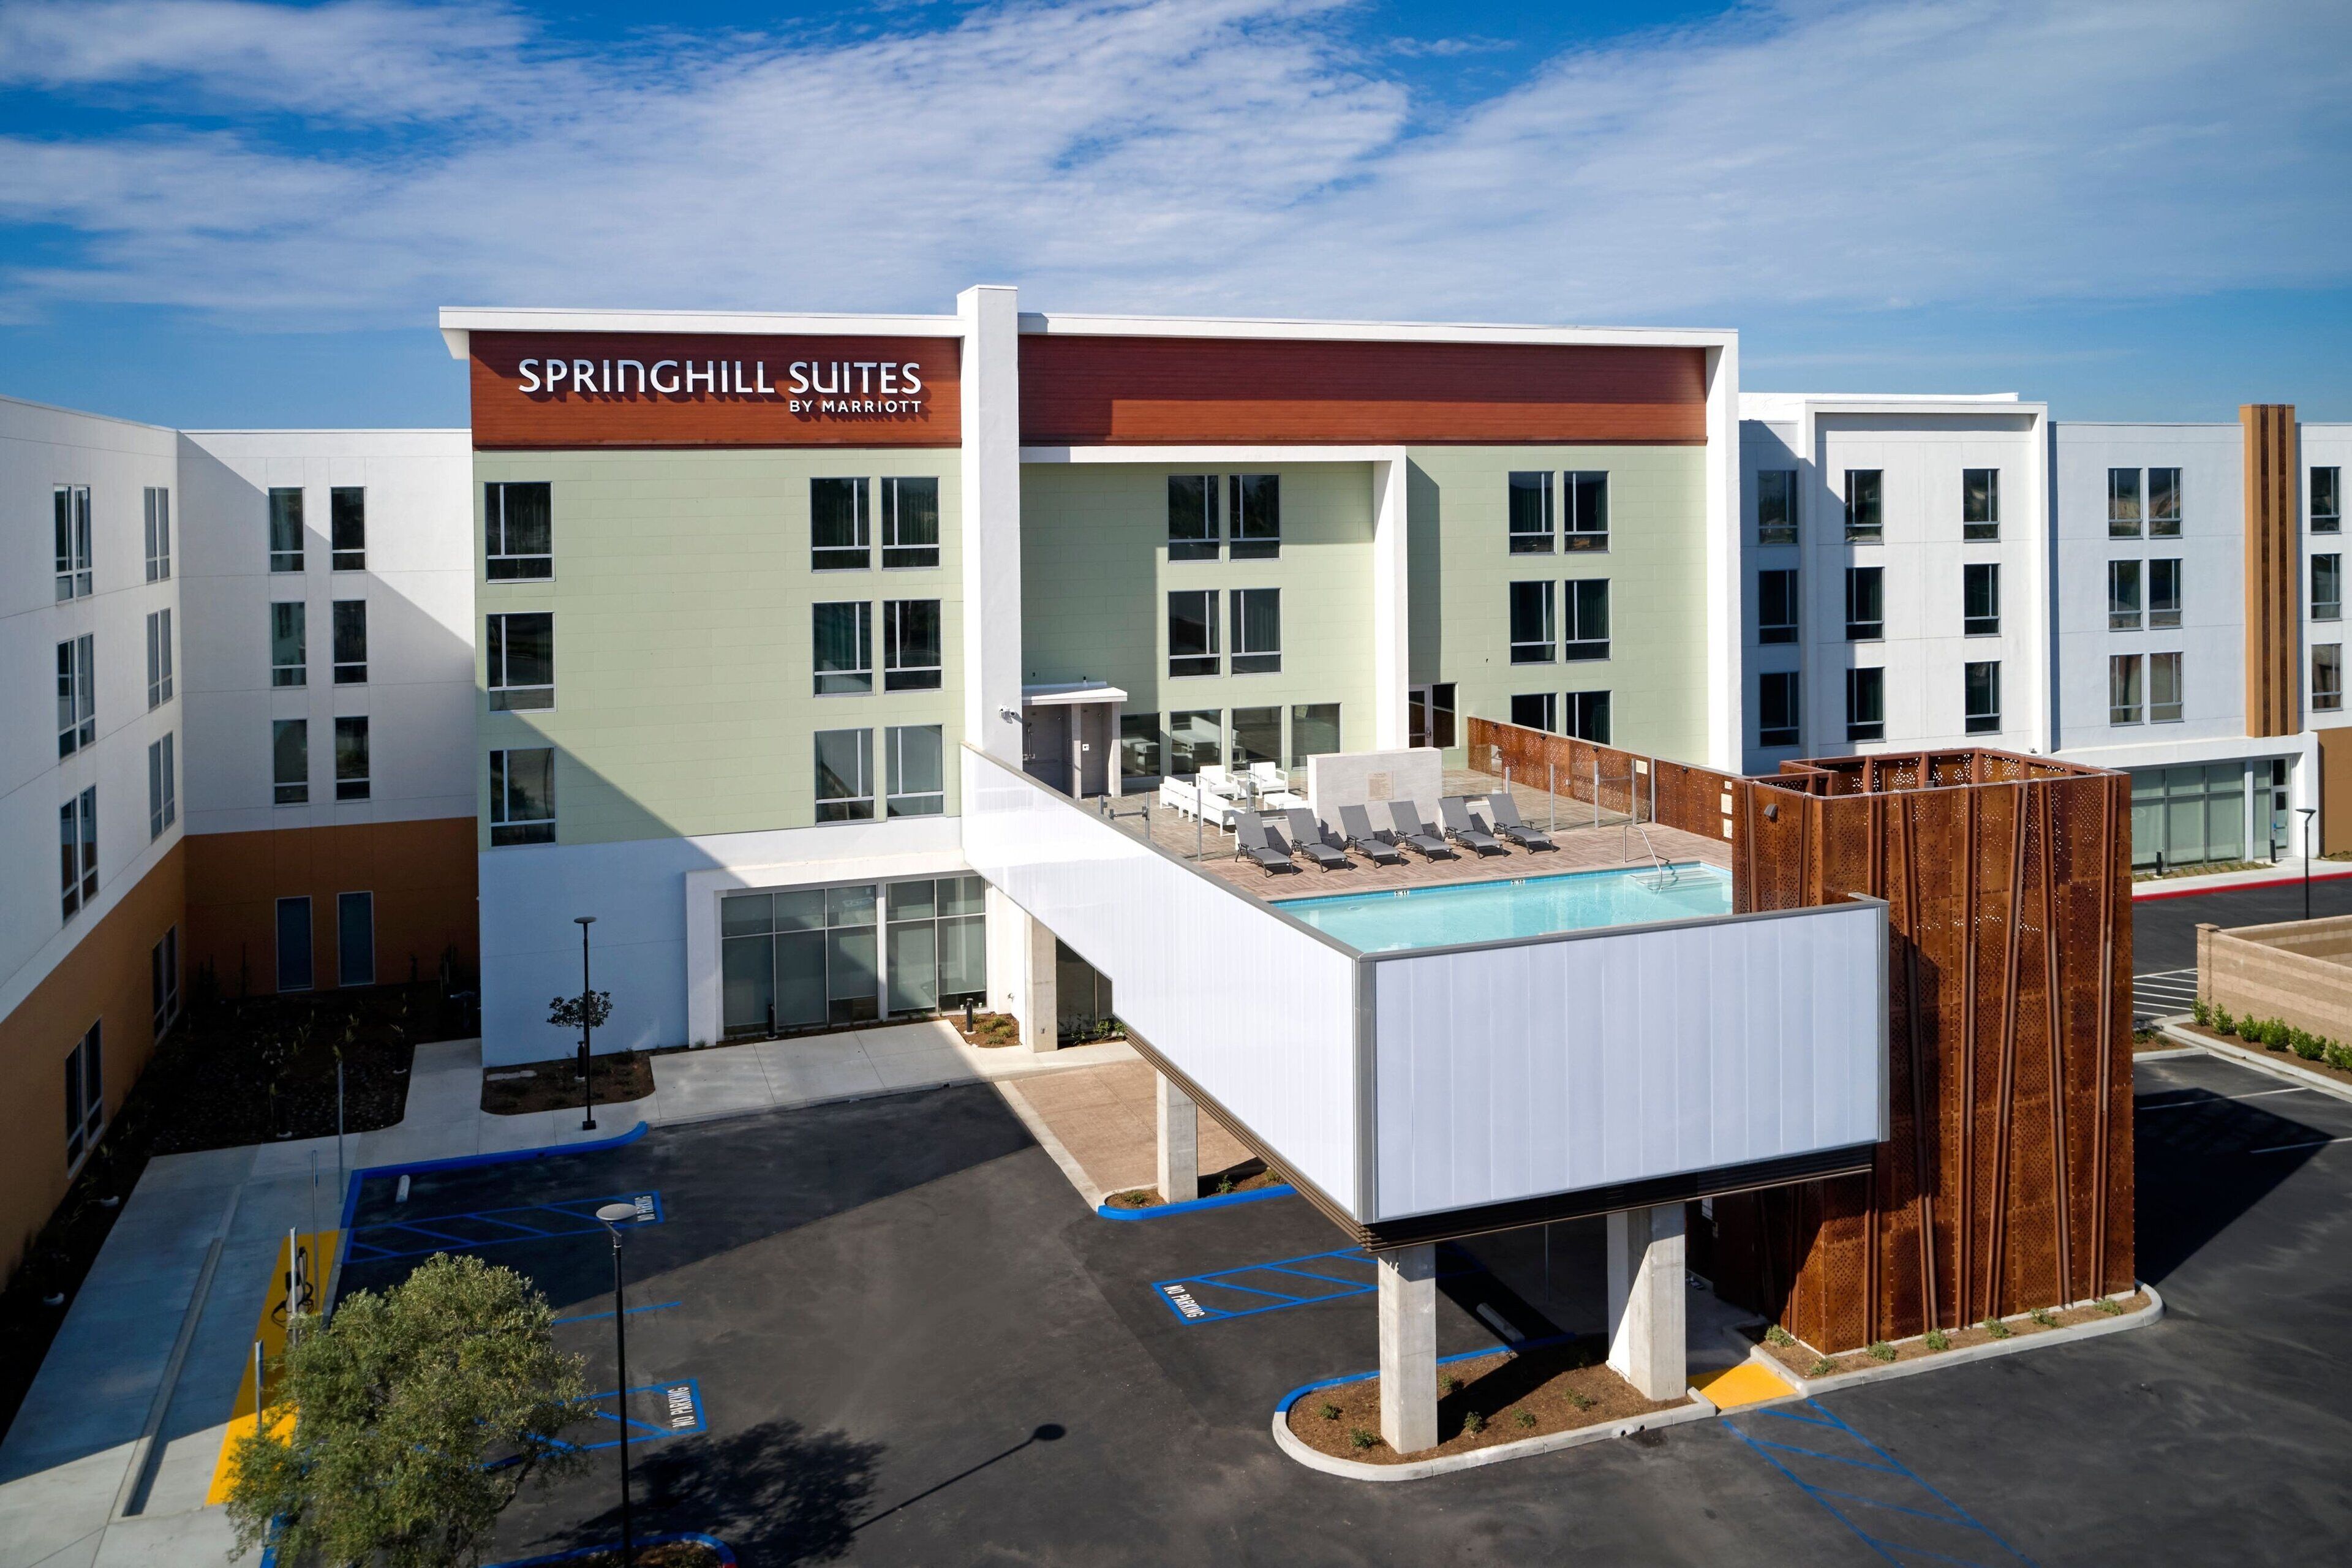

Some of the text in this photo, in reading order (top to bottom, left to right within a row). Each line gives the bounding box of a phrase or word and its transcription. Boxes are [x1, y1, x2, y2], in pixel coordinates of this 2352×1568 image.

[518, 358, 921, 394] SPRINGHILL SUITES
[790, 400, 922, 413] BY MARRIOTT
[637, 1213, 655, 1222] NO
[1164, 1284, 1205, 1317] NO PARKING
[668, 1387, 695, 1428] NO PARKING
